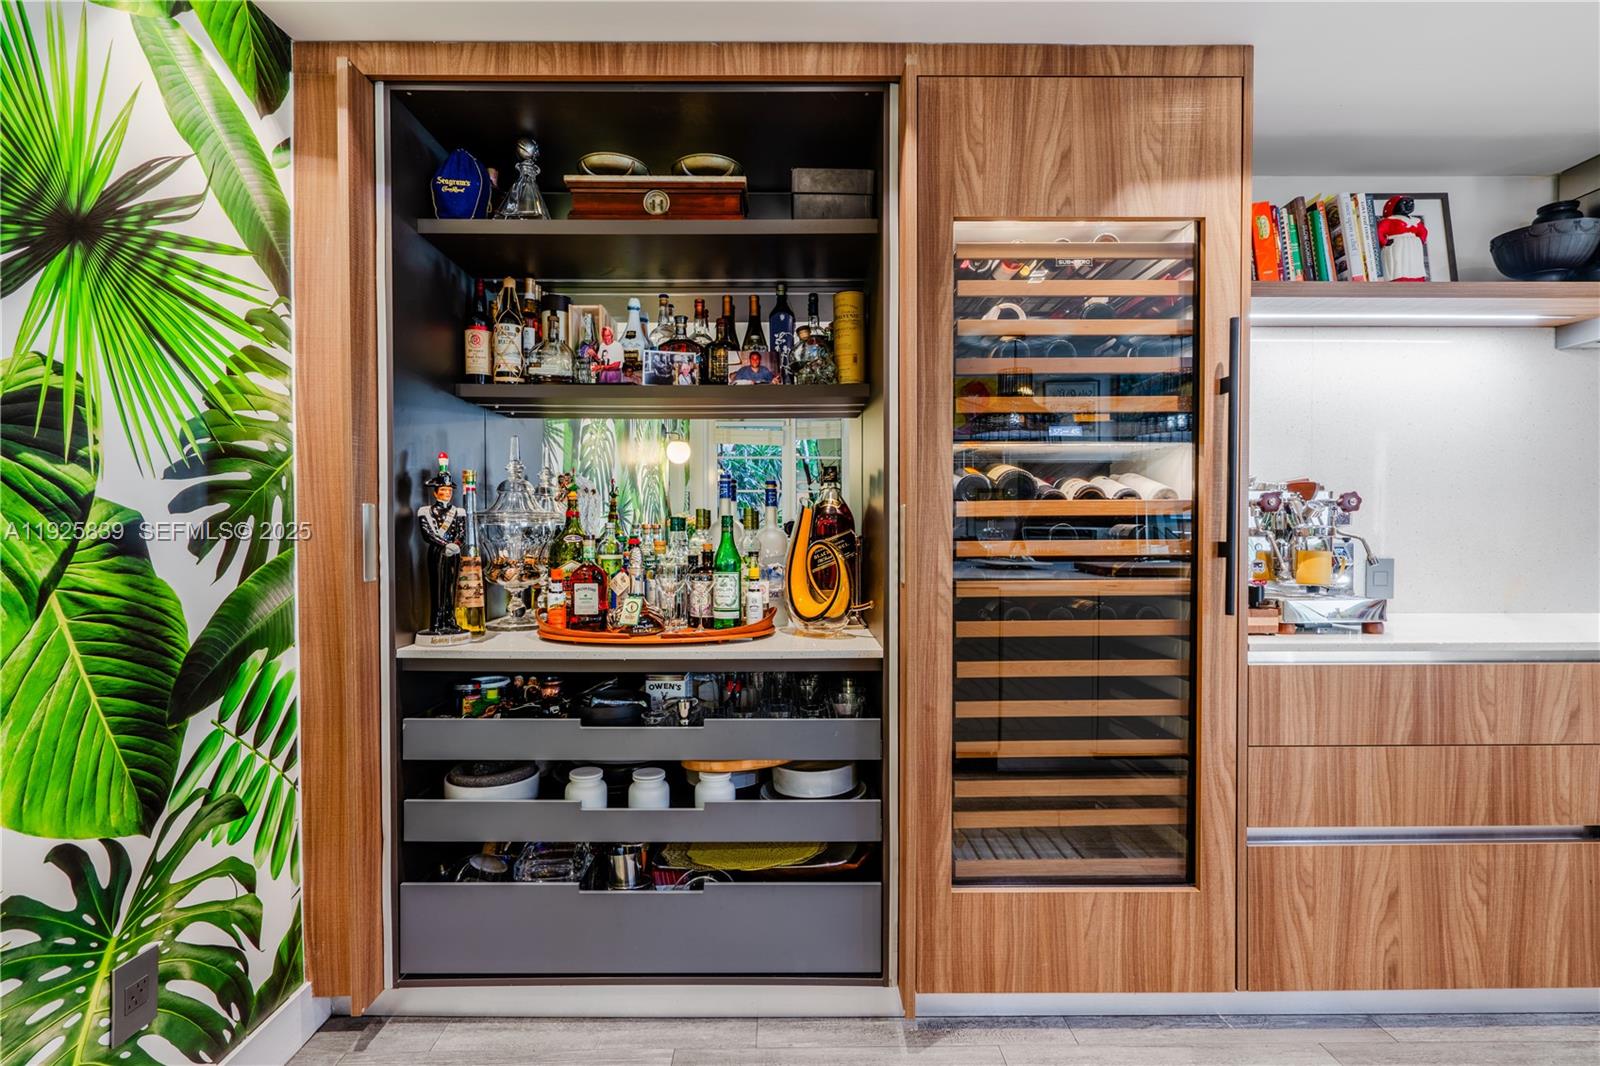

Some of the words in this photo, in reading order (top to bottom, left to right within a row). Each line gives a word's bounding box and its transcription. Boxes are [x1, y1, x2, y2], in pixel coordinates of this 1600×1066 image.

[436, 176, 471, 187] Seagram's
[1304, 241, 1313, 266] COOKING
[648, 683, 682, 691] OWEN'S
